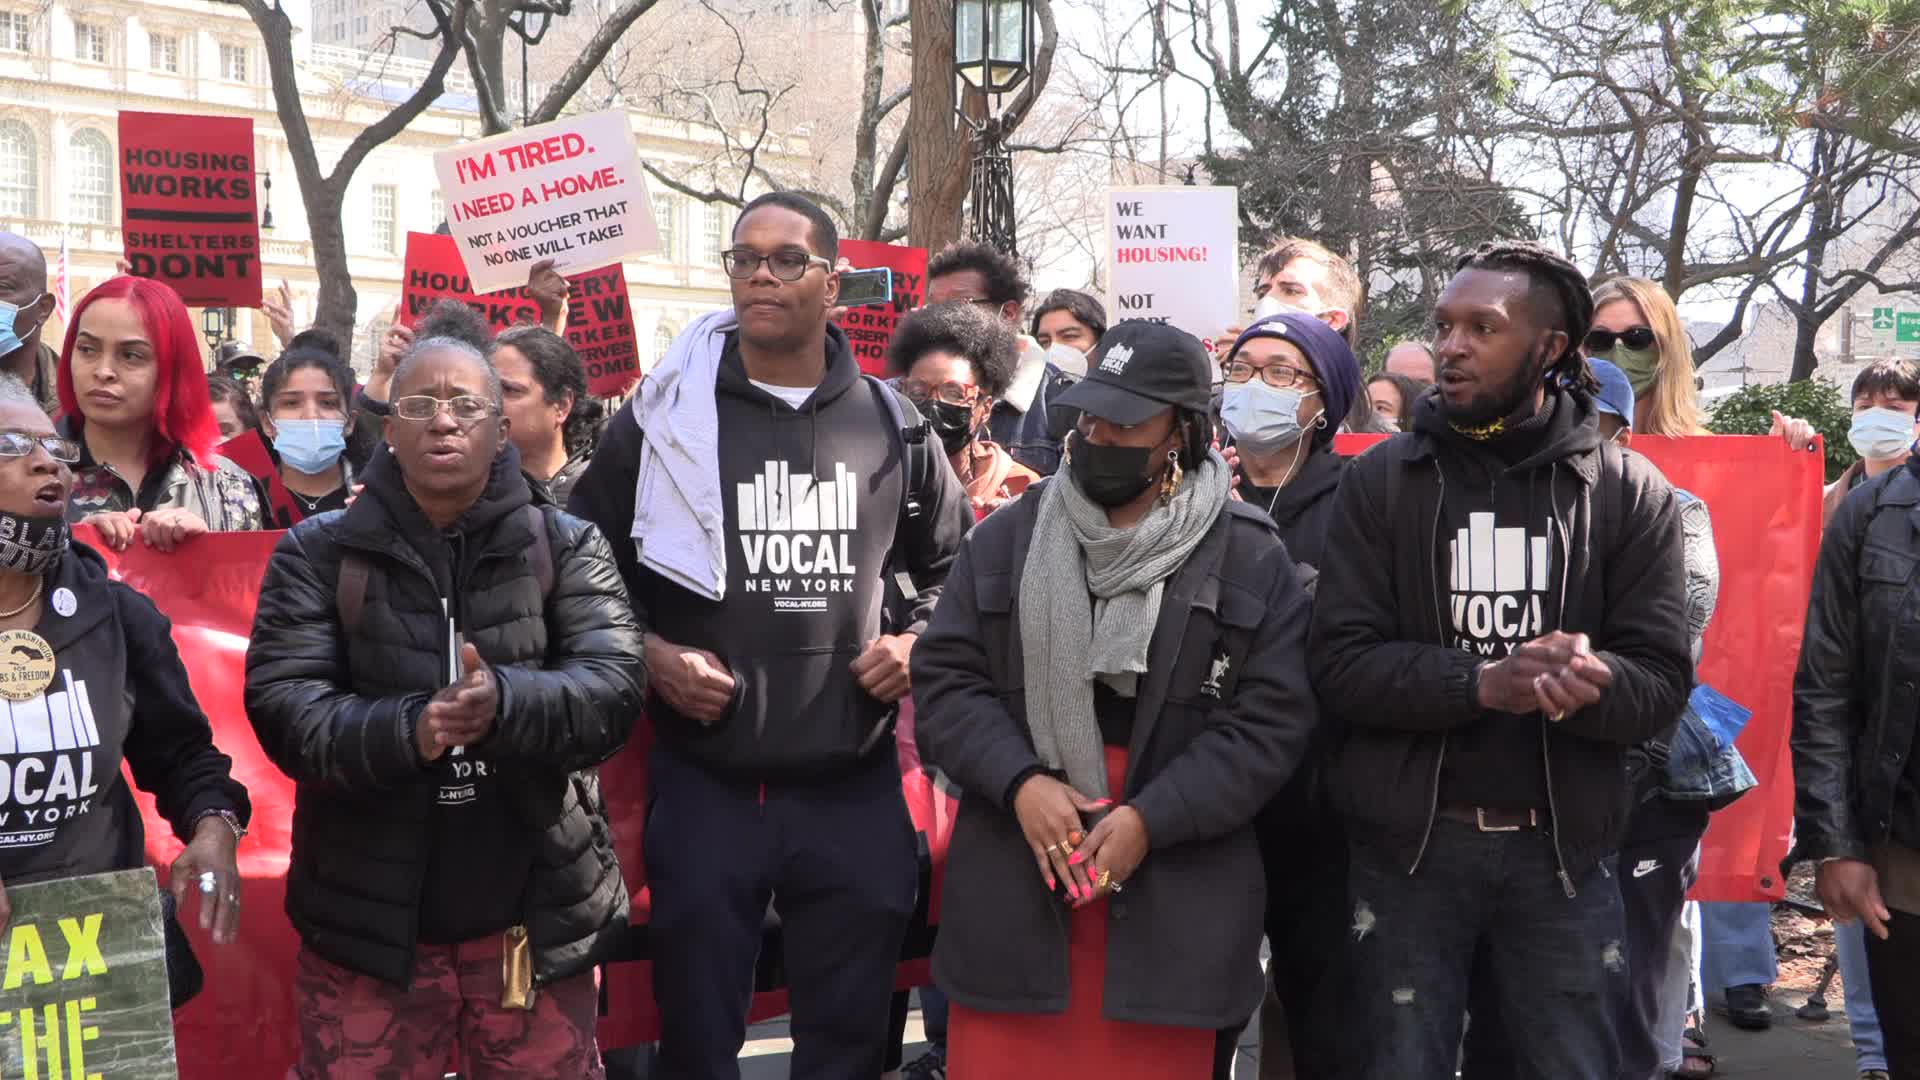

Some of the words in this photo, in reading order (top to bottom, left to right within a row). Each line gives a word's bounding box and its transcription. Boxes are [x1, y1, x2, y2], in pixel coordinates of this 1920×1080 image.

[126, 149, 249, 172] HOUSING
[456, 153, 496, 184] I'M
[498, 132, 596, 172] TIRED.
[126, 173, 251, 199] WORKS
[453, 203, 461, 222] I
[462, 192, 515, 220] NEED
[522, 187, 538, 207] A
[541, 167, 625, 200] HOME.
[1116, 202, 1144, 216] WE
[468, 232, 493, 248] NOT
[497, 231, 506, 243] A
[507, 212, 582, 241] VOUCHER
[584, 201, 628, 222] THAT
[1117, 224, 1168, 239] WANT
[128, 232, 255, 249] SHELTERS
[484, 252, 503, 267] NO
[505, 246, 532, 262] ONE
[533, 237, 574, 256] WILL
[576, 223, 625, 246] TAKE!
[130, 252, 255, 279] DONT
[1117, 247, 1208, 264] HOUSING!
[568, 270, 619, 299] ERY
[568, 295, 625, 326] EW
[1118, 293, 1155, 309] NOT
[568, 323, 631, 344] RKER
[587, 355, 635, 378] OME
[740, 533, 856, 574] VOCAL
[745, 579, 792, 592] NEW
[801, 579, 853, 592] YORK
[1451, 594, 1542, 638] VOCA
[18, 670, 51, 681] FREEDOM
[452, 760, 497, 778] YOR
[24, 800, 91, 825] YORK
[3, 912, 108, 991] AX
[0, 996, 103, 1080] HE
